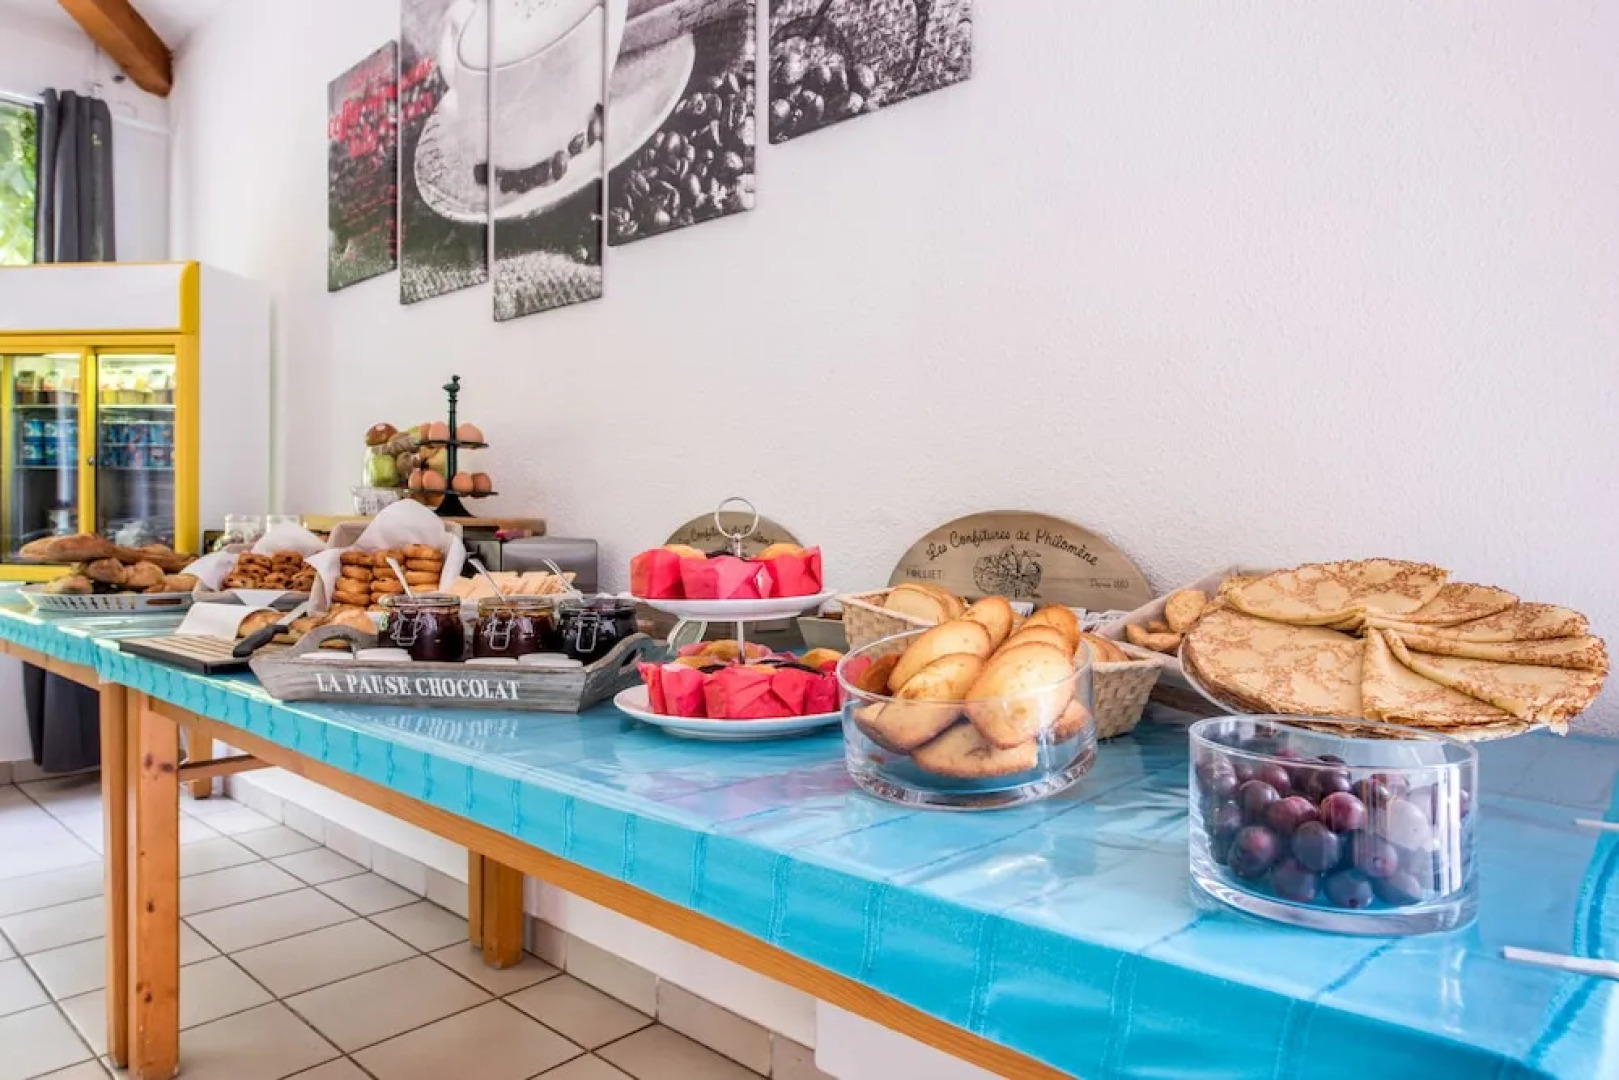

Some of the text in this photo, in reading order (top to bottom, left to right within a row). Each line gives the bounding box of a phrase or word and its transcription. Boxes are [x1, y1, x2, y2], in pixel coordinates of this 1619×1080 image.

[926, 542, 947, 561] Les
[950, 529, 1011, 548] Confitures
[1015, 529, 1031, 541] de
[317, 674, 521, 700] LA PAUSE CHOCOLAT
